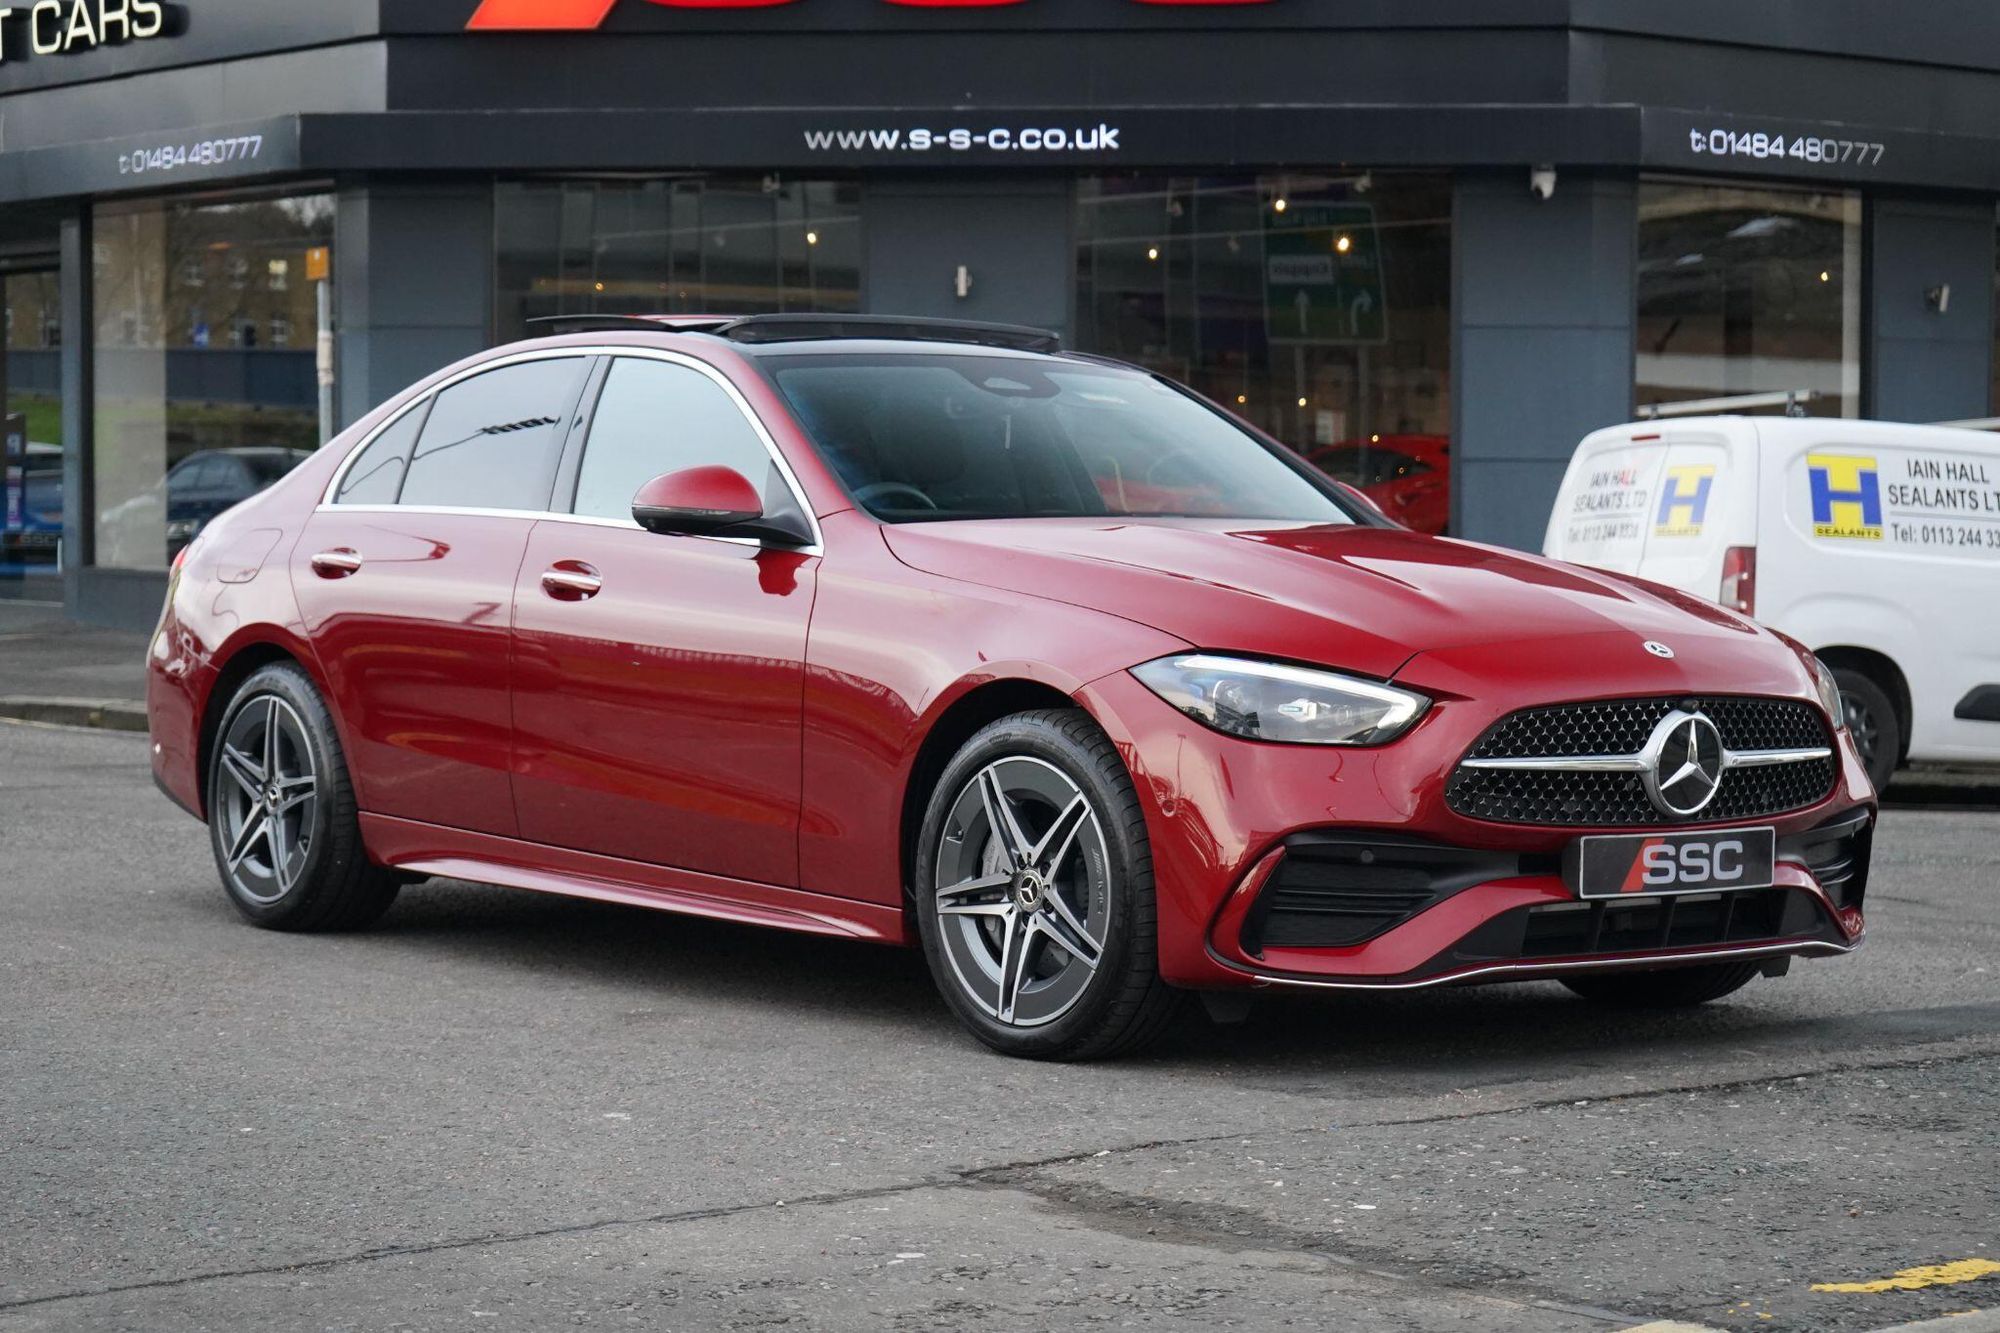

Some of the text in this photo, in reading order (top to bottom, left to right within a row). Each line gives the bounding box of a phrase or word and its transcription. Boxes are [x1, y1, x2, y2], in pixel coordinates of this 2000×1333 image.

[31, 0, 162, 55] CARS
[803, 123, 1120, 150] www.s-s-c.co.uk
[1788, 137, 1885, 166] 480777
[1907, 458, 1990, 484] IAIN HALL
[1888, 484, 1979, 511] SEALANTS
[1816, 527, 1881, 538] SEALANTS
[1891, 524, 1917, 543] Tel:
[1922, 526, 1954, 546] 0113
[1958, 528, 1982, 546] 244
[1642, 840, 1743, 885] SSC
